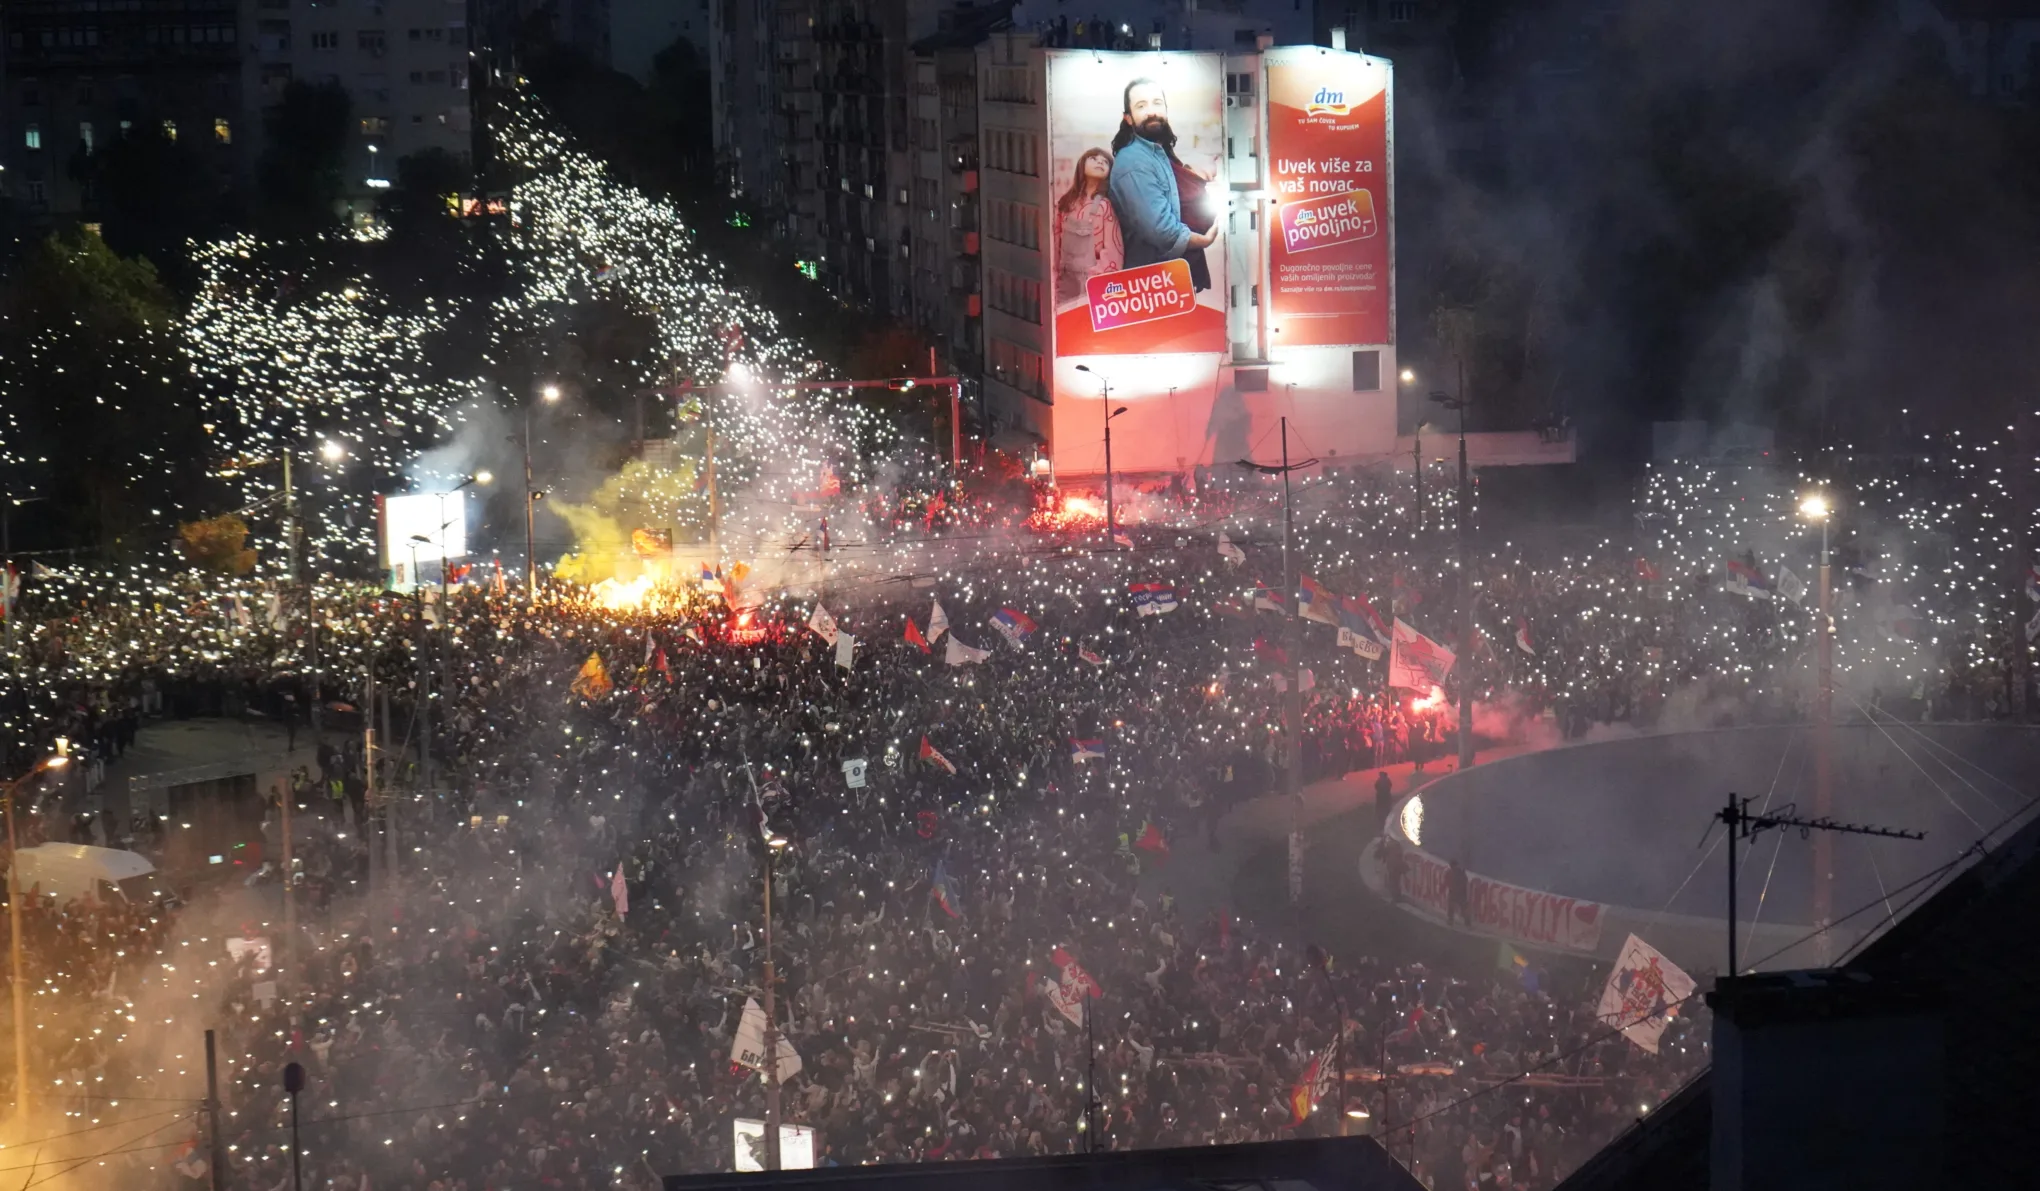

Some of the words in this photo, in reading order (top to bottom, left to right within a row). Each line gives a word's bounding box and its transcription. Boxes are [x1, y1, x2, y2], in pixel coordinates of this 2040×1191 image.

[1315, 87, 1343, 104] dm
[1278, 157, 1317, 174] Uvek
[1320, 157, 1350, 174] više
[1355, 160, 1372, 172] za
[1278, 176, 1305, 193] vaš
[1299, 210, 1313, 220] dm
[1317, 199, 1358, 221] uvek
[1280, 263, 1320, 273] Dugoročno
[1322, 263, 1352, 272] povoljne
[1106, 283, 1123, 293] dm
[1128, 270, 1175, 295] uvek
[1280, 273, 1299, 282] vaših
[1301, 273, 1336, 282] omiljenih
